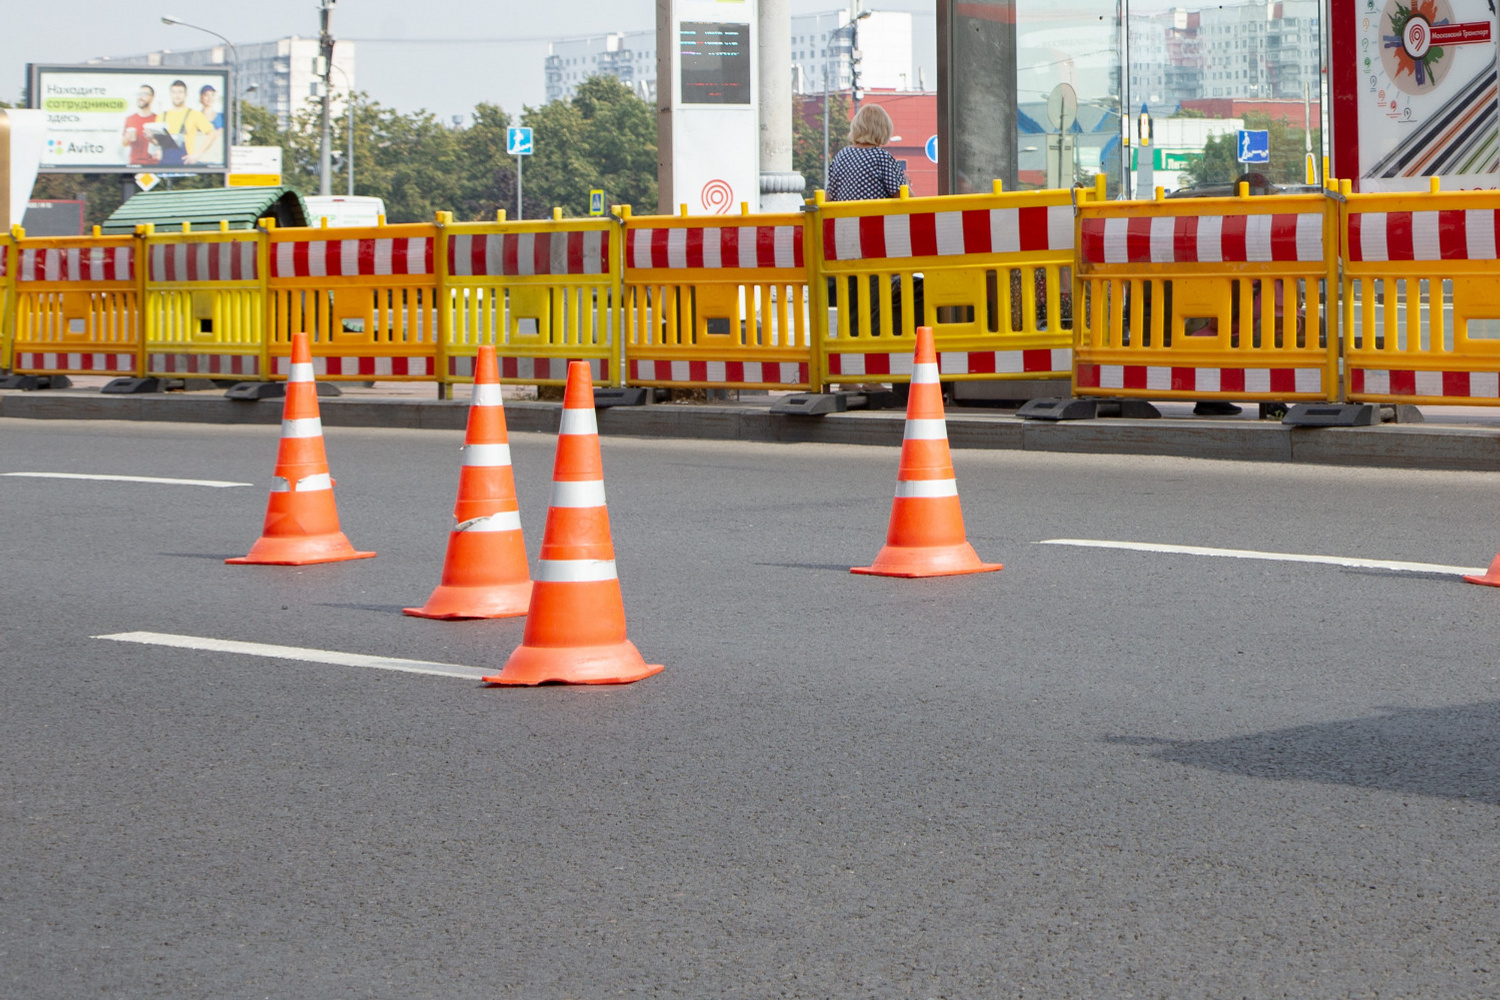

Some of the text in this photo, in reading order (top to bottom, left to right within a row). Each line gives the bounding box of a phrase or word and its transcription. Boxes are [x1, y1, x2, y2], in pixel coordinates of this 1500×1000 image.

[47, 84, 106, 95] Находите
[46, 99, 124, 111] сотрудников
[47, 114, 80, 123] здесь
[67, 141, 104, 154] Avito
